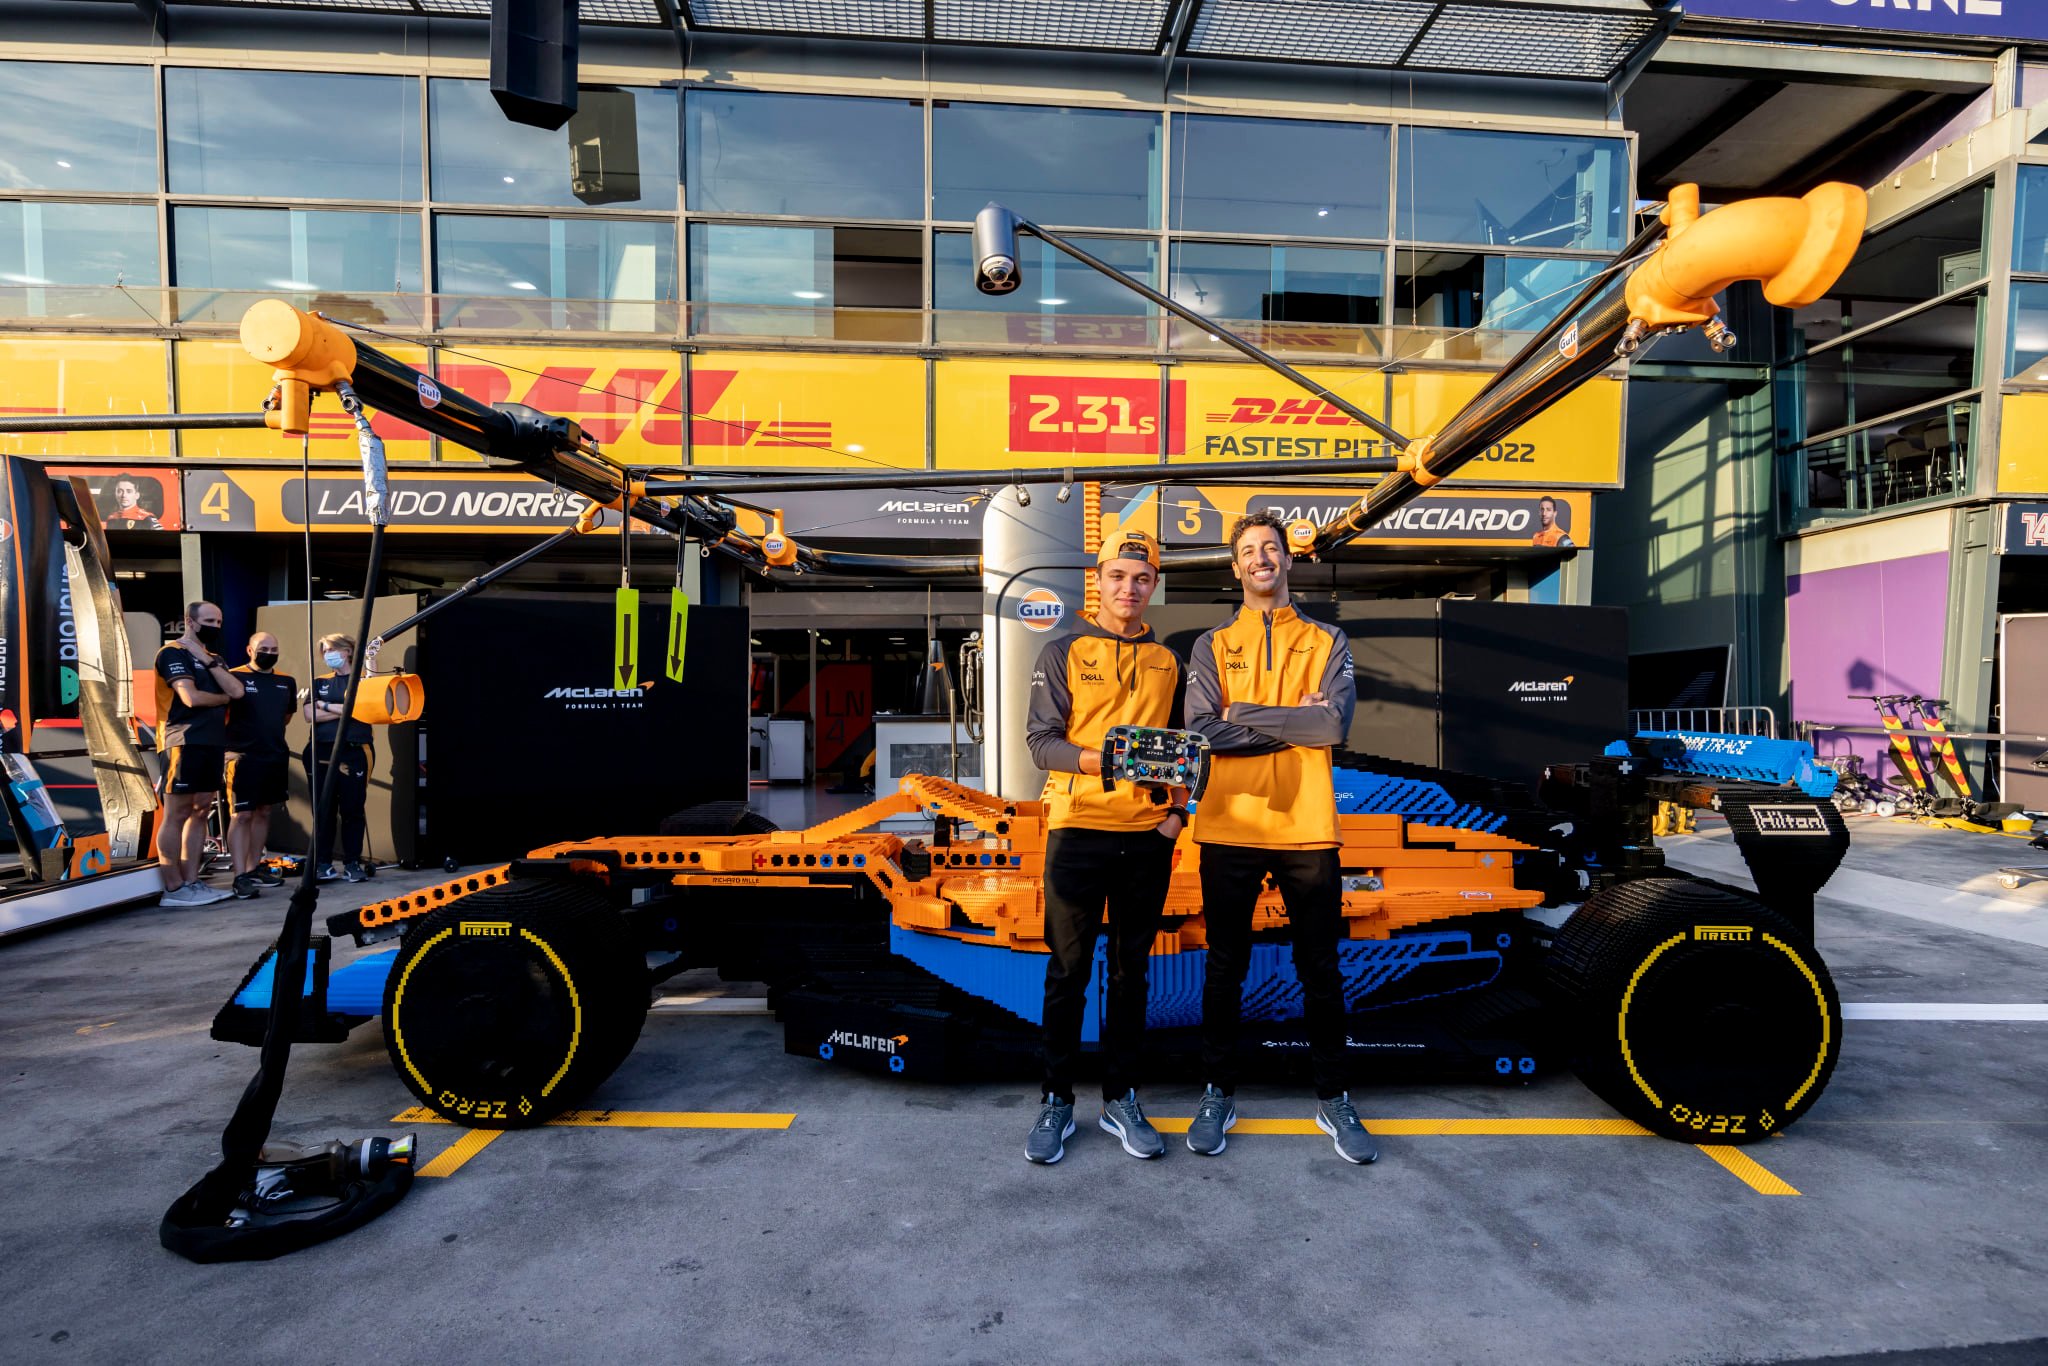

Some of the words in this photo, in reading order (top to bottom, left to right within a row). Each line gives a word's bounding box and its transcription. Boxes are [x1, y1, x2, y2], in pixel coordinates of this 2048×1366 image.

[1561, 330, 1577, 350] Gulf
[419, 383, 440, 401] Gulf
[1028, 394, 1156, 435] 2.31s
[1228, 397, 1352, 426] DHL
[1205, 435, 1327, 458] FASTEST
[1334, 438, 1379, 458] PIT
[200, 482, 230, 521] 4
[450, 491, 588, 518] NORRIS
[878, 501, 970, 513] McLaren
[1177, 500, 1202, 535] 3
[1019, 604, 1061, 616] Gulf
[1080, 673, 1104, 681] DELL
[1508, 681, 1567, 692] McLaren
[544, 687, 644, 698] McLaren
[825, 689, 865, 717] LN
[825, 719, 845, 744] 4
[1153, 735, 1164, 750] 1
[1757, 810, 1822, 829] Hilton
[460, 921, 513, 936] PIRELLI
[1694, 925, 1753, 941] PIRELLI
[439, 1090, 507, 1118] ZERO
[1669, 1104, 1746, 1134] ZERO
